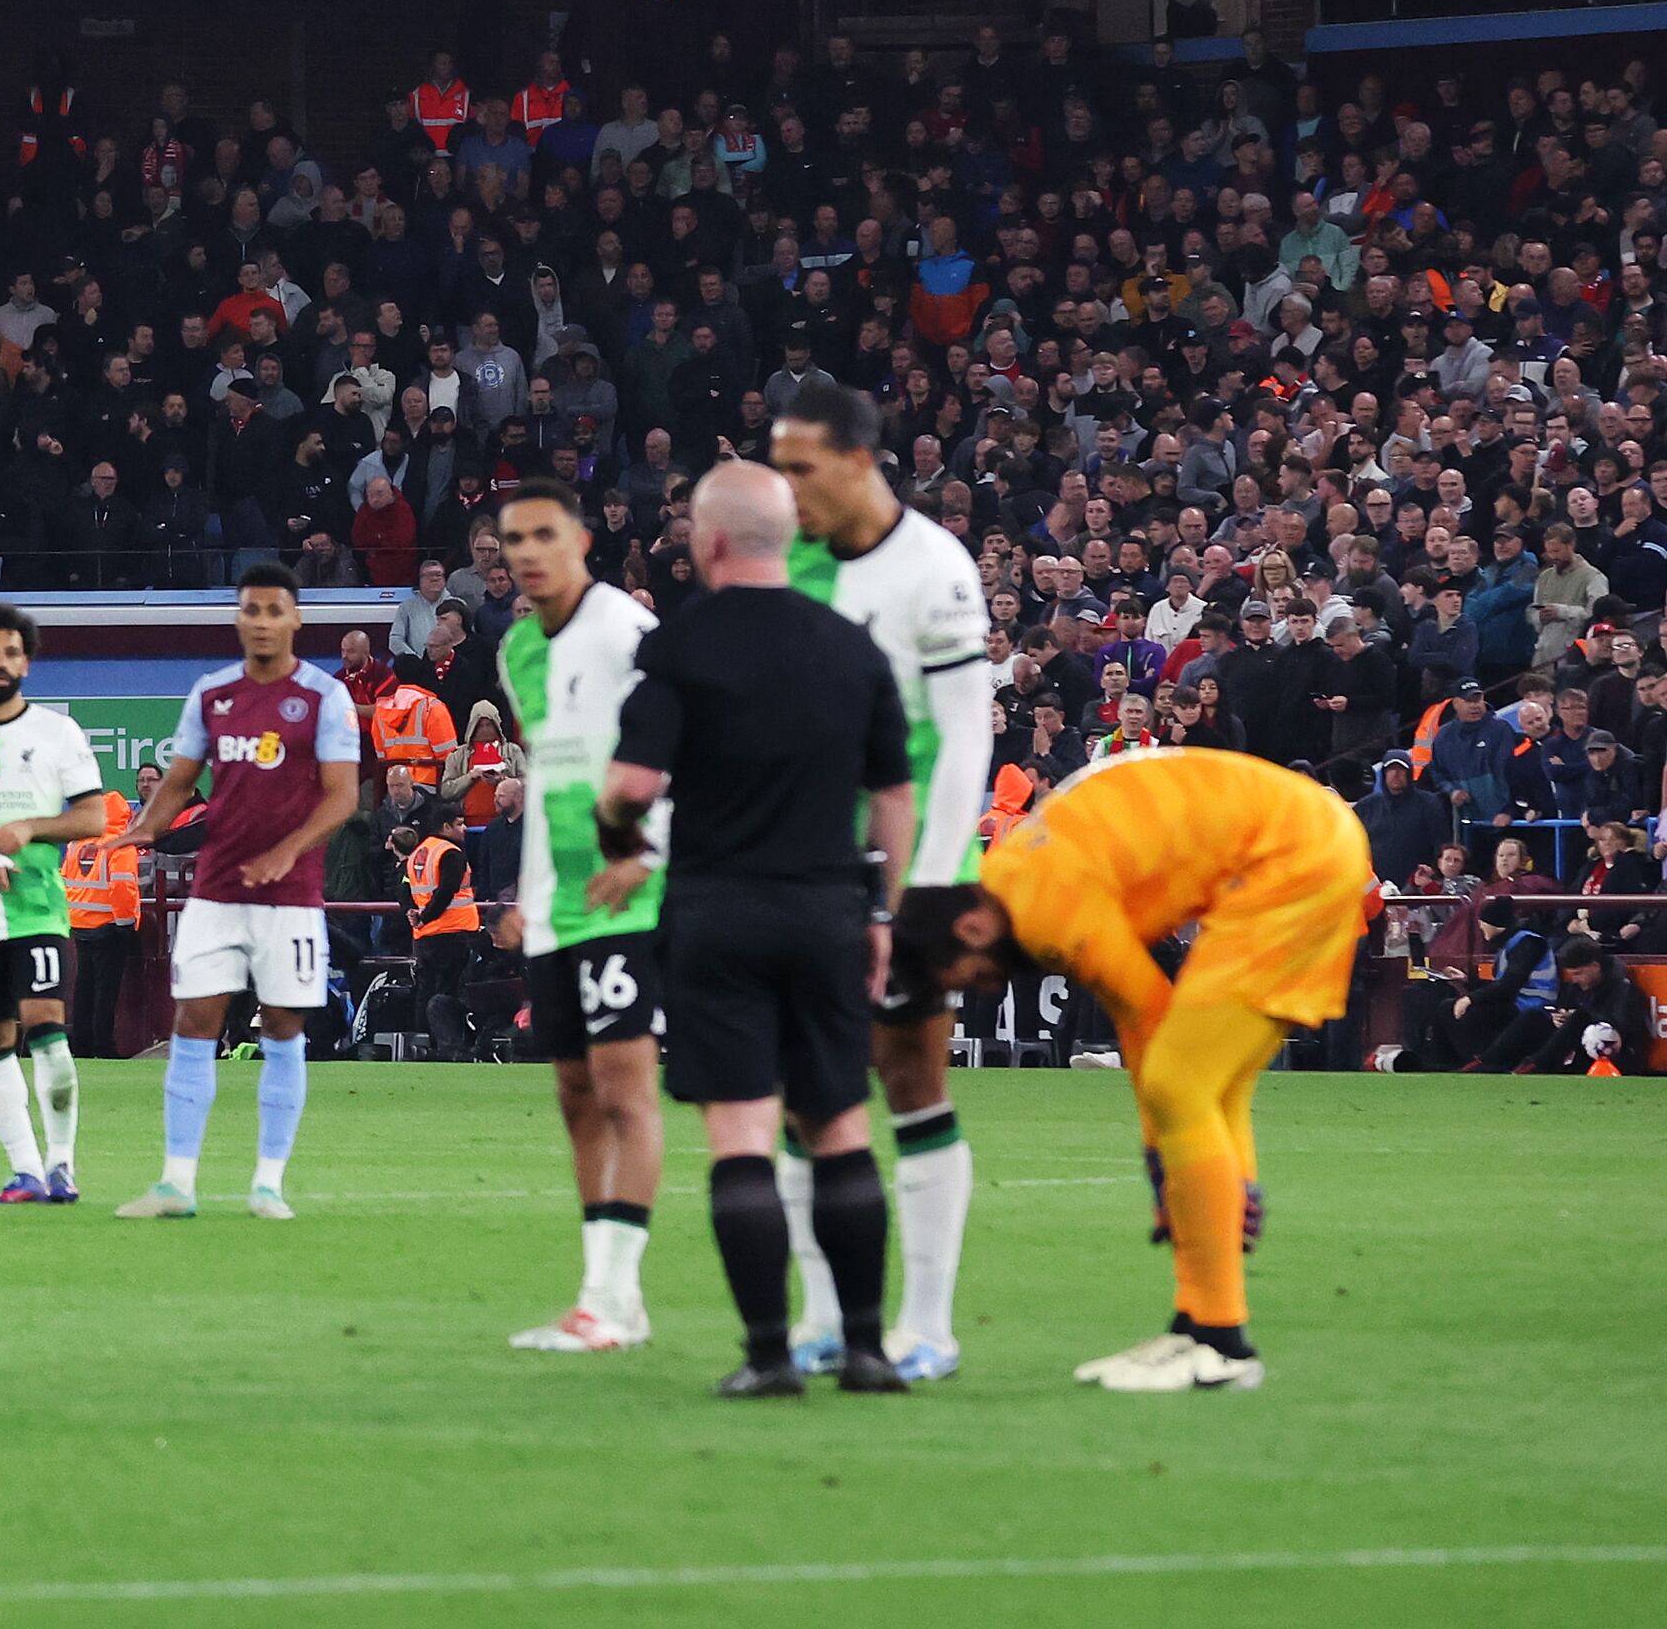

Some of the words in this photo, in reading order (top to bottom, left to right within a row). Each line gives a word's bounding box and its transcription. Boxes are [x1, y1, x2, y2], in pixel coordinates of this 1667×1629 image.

[83, 727, 177, 770] Fire
[218, 730, 287, 770] BK8
[30, 946, 60, 984] 11
[292, 937, 315, 972] 11
[578, 953, 639, 1013] 66
